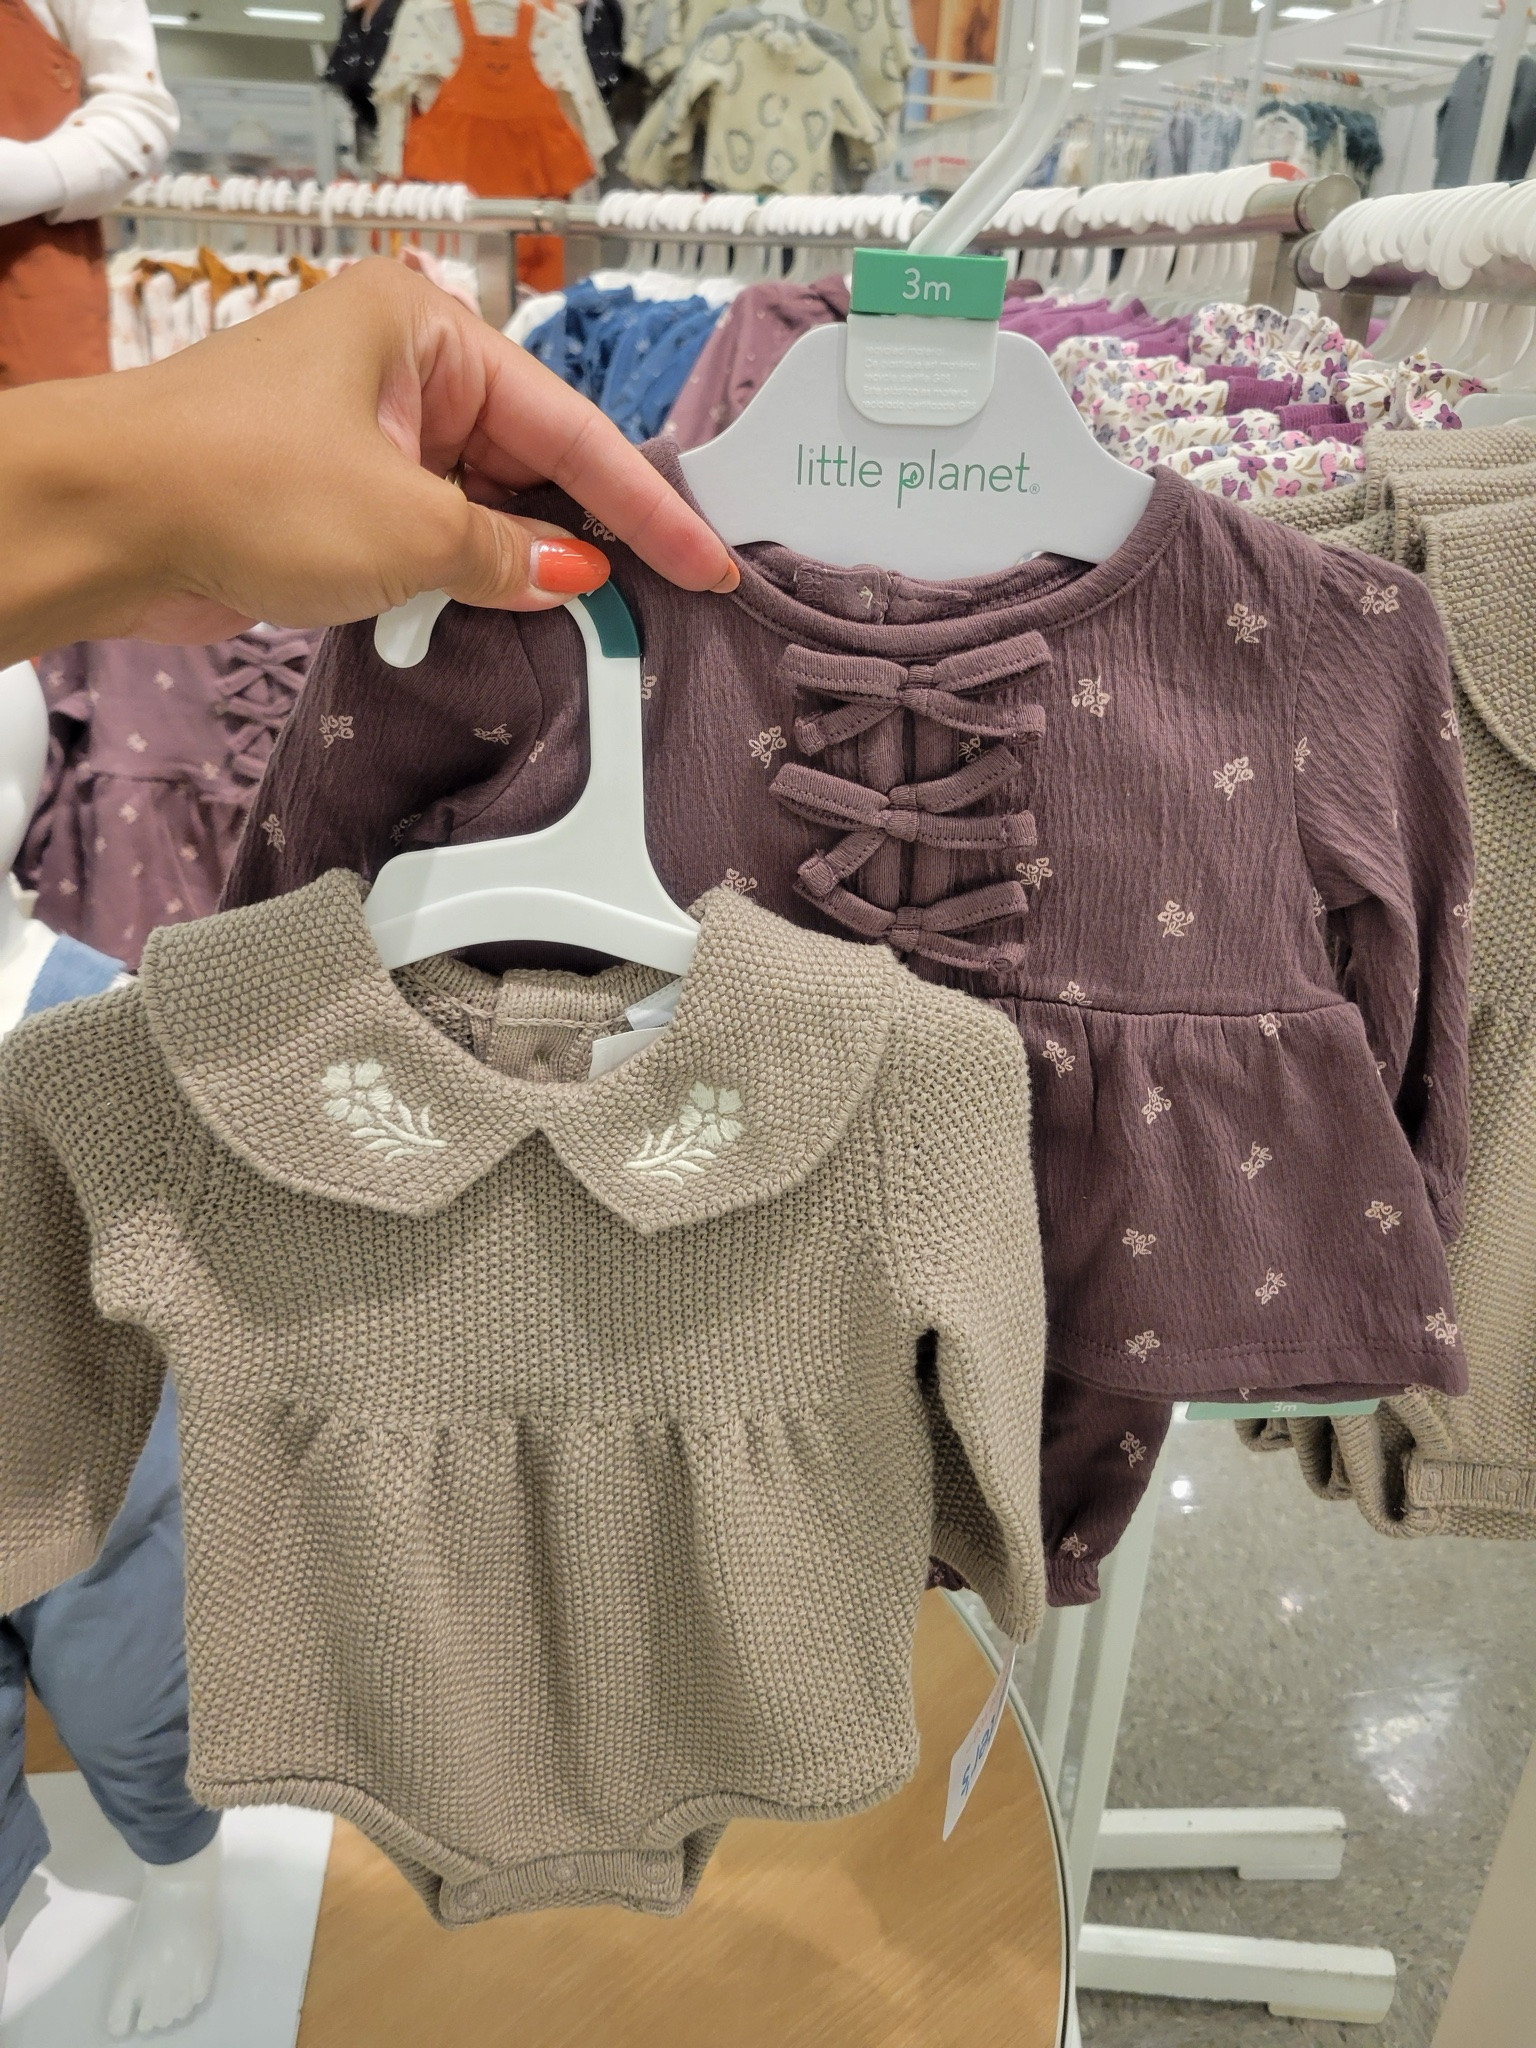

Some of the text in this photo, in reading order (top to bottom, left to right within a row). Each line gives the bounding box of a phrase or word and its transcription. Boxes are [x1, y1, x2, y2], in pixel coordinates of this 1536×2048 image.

[902, 267, 950, 301] 3m
[797, 444, 883, 488] little
[1272, 1402, 1297, 1413] 3m
